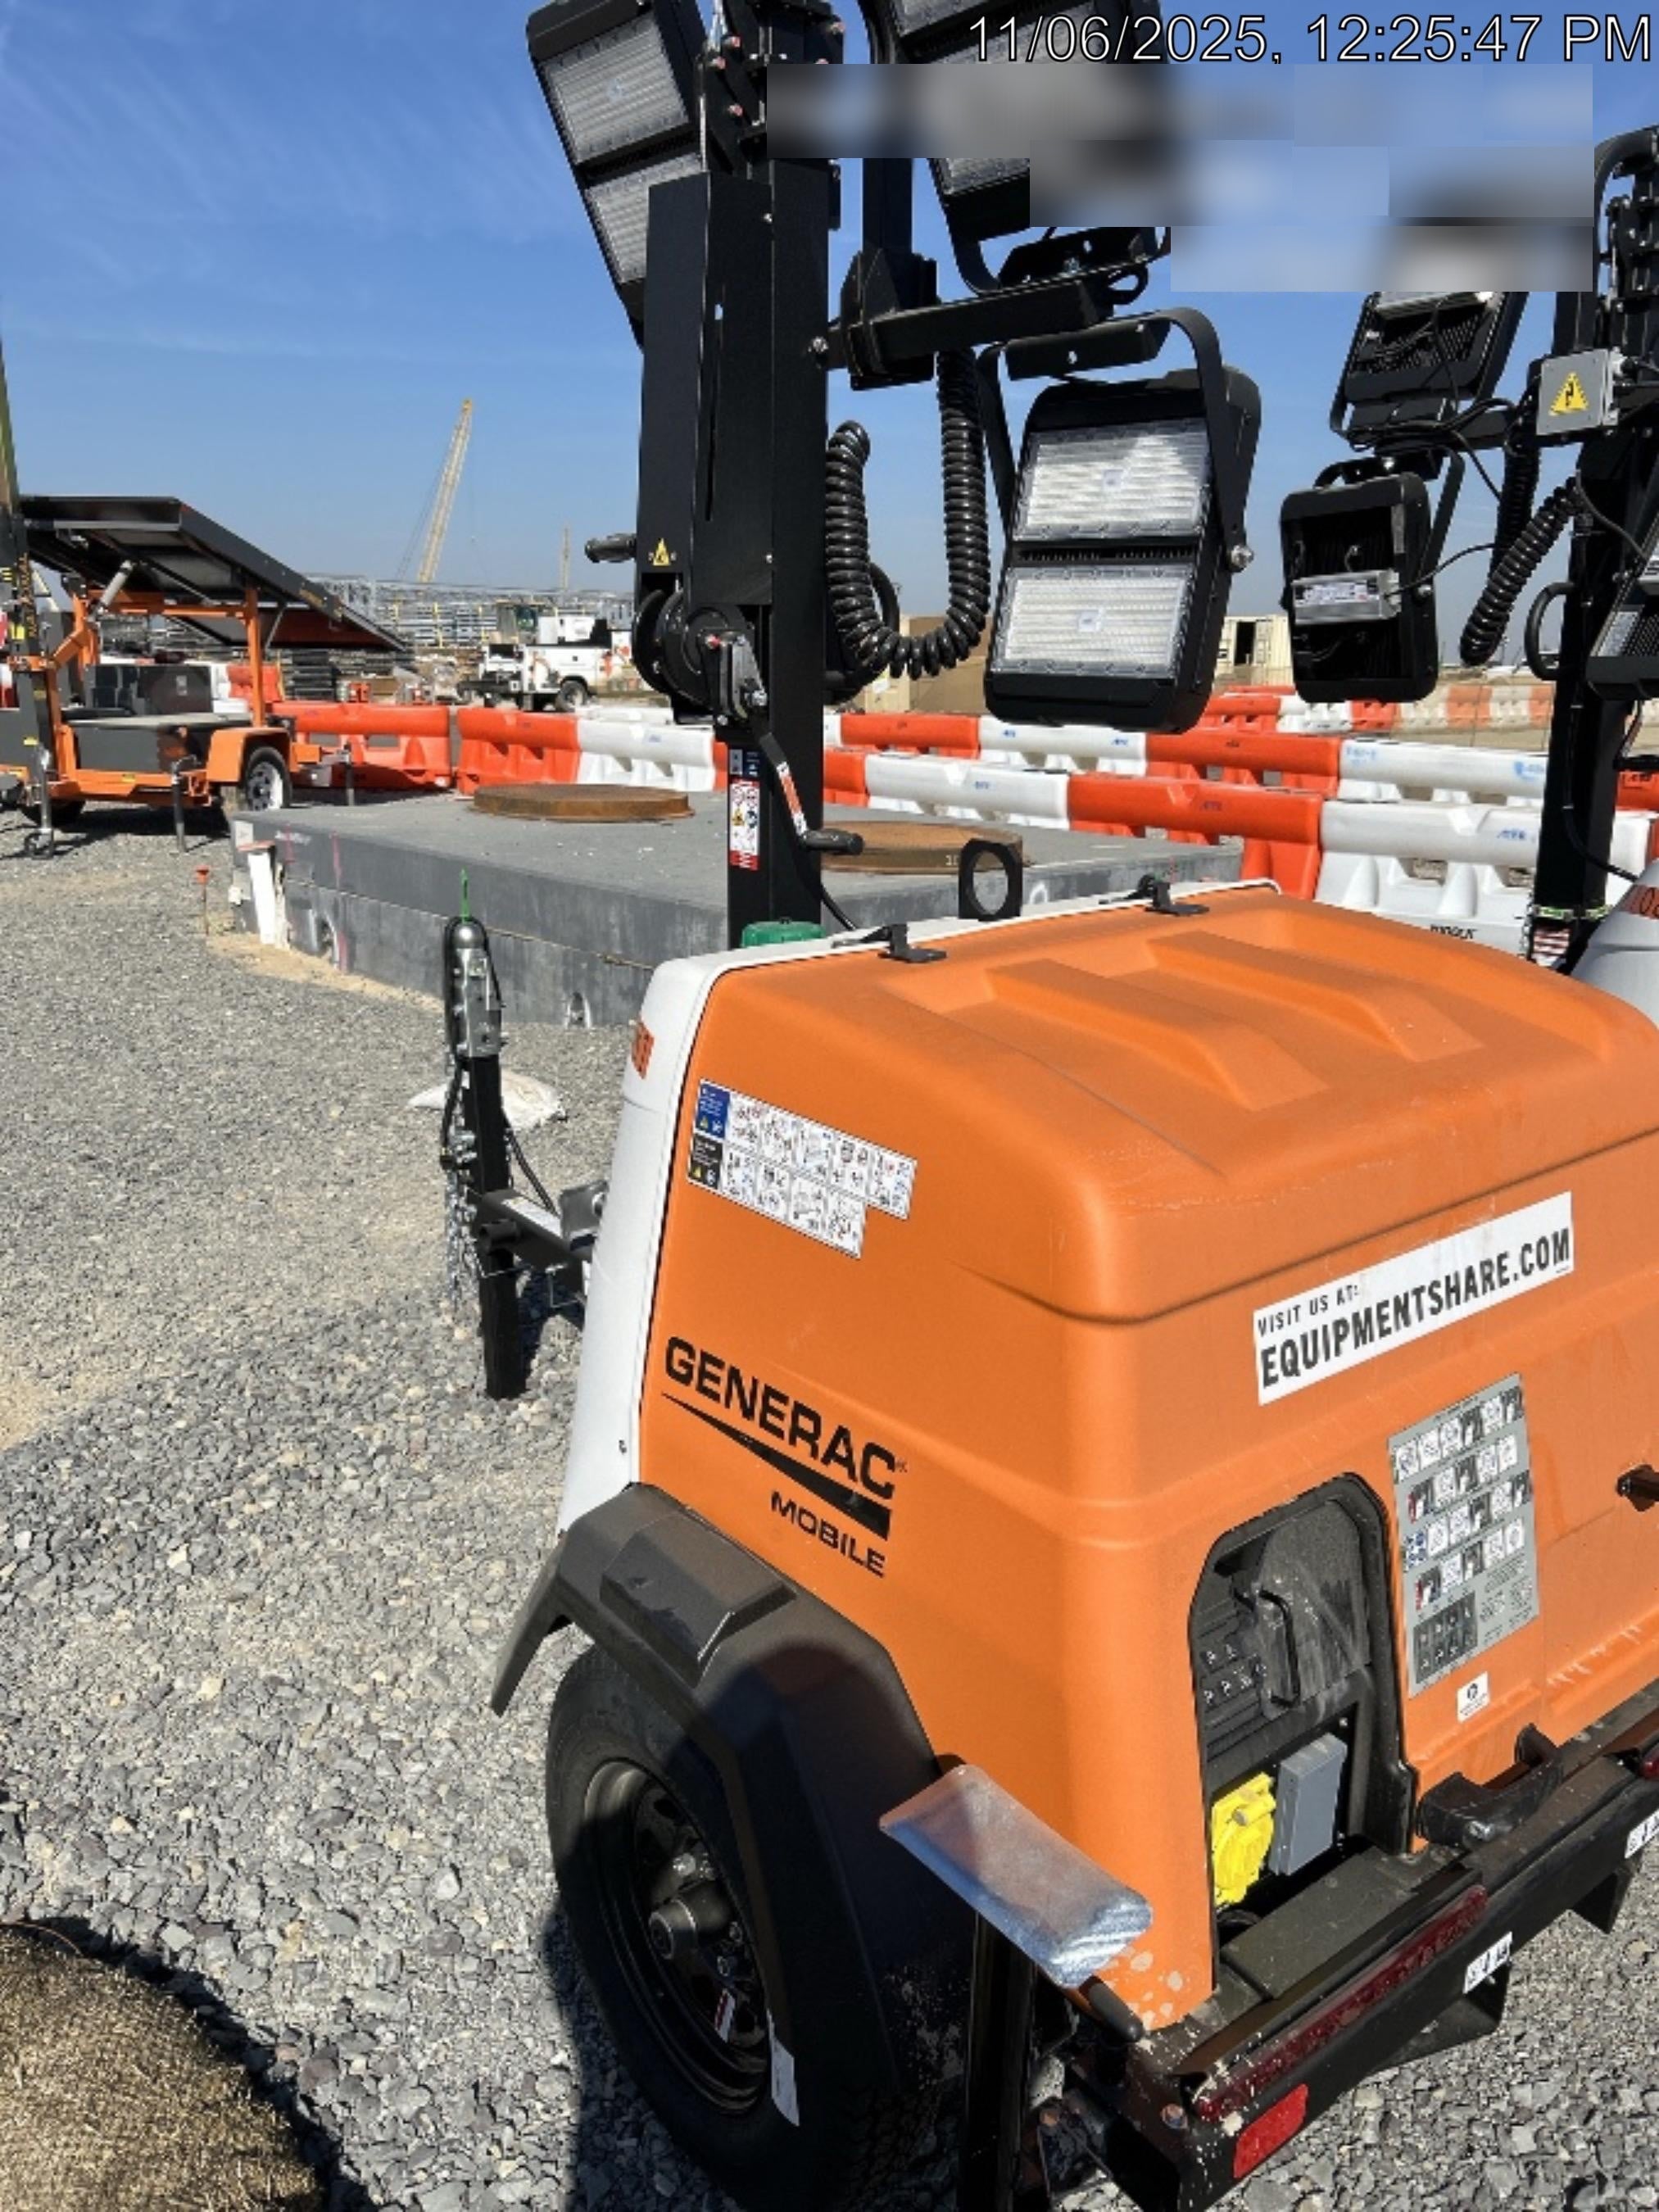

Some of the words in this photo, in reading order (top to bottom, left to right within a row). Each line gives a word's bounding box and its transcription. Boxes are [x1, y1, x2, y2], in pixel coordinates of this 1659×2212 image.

[1257, 1304, 1302, 1337] VISIT
[1309, 1294, 1329, 1317] US
[1336, 1284, 1358, 1306] AT:
[1260, 1227, 1571, 1389] EQUIPMENTSHARE.COM
[664, 1335, 896, 1501] GENERAC
[770, 1490, 886, 1579] MOBILE
